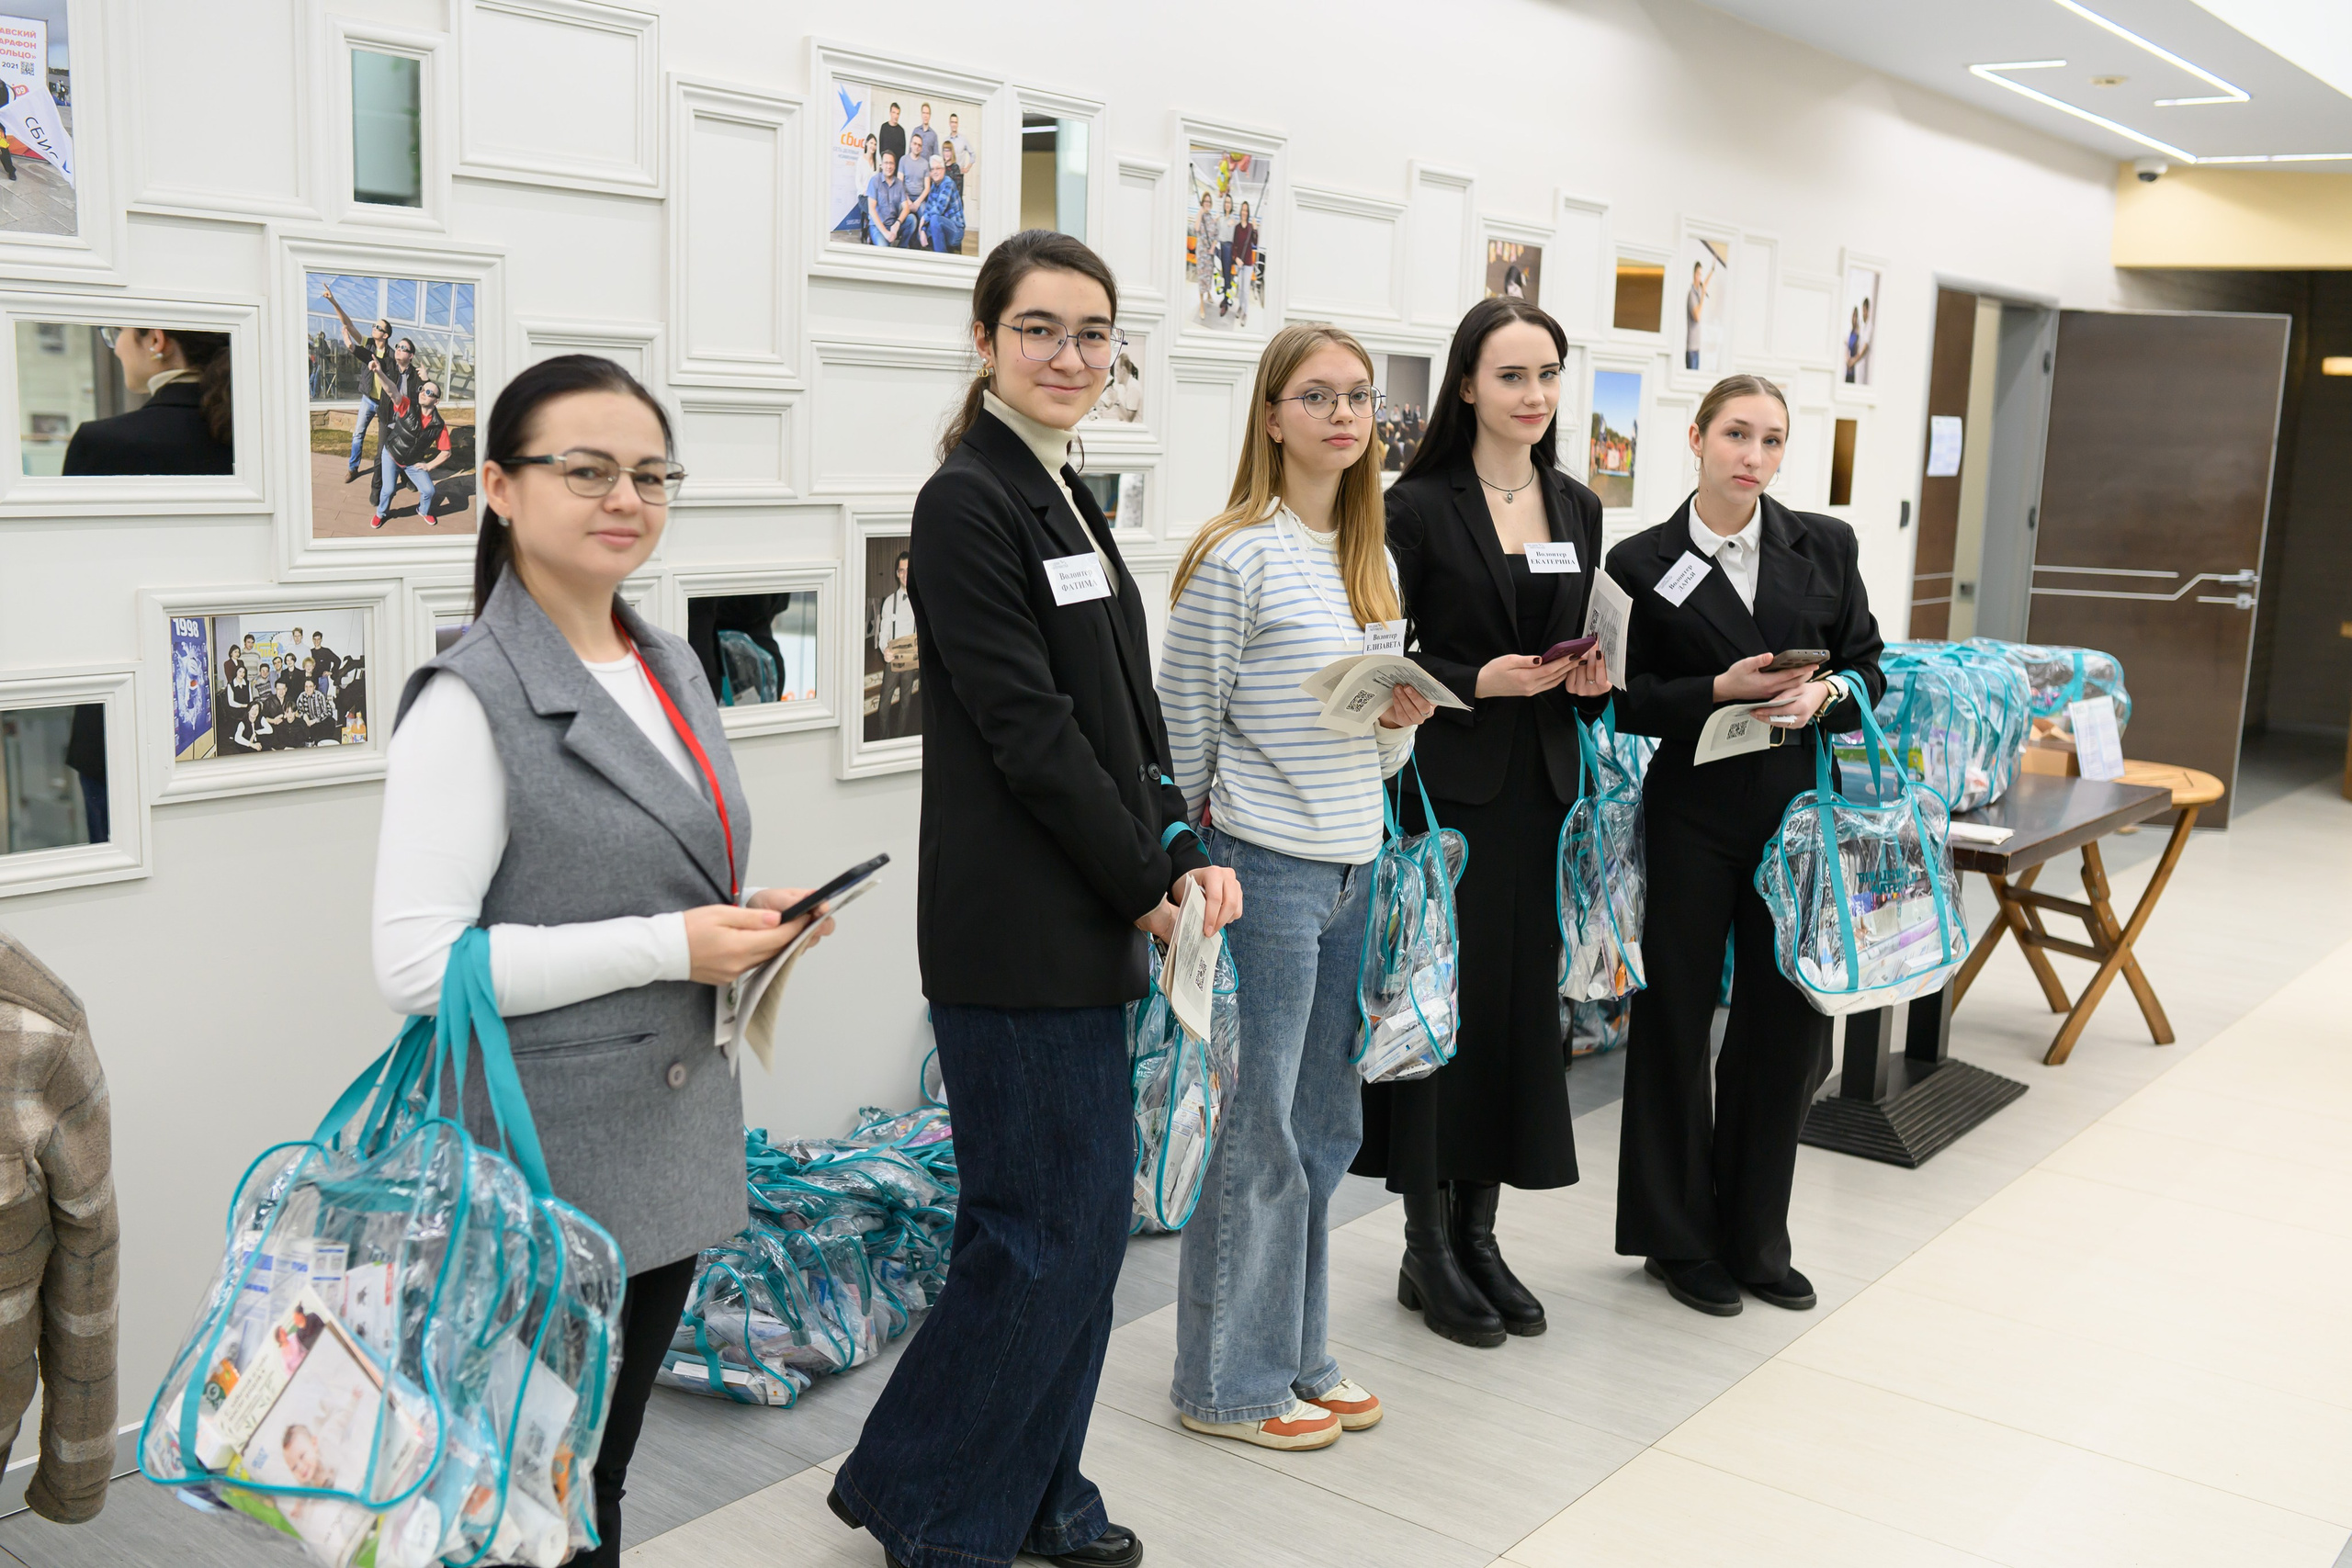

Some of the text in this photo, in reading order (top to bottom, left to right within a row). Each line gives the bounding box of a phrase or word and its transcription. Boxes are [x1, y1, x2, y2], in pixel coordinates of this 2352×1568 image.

[2, 62, 18, 70] 2021
[1058, 570, 1093, 581] Волонтер
[1061, 579, 1098, 592] ФАТИМА
[172, 617, 199, 638] 1998
[1373, 633, 1398, 641] Волонтер
[1366, 641, 1401, 652] ЕЛИЗАВЕТА
